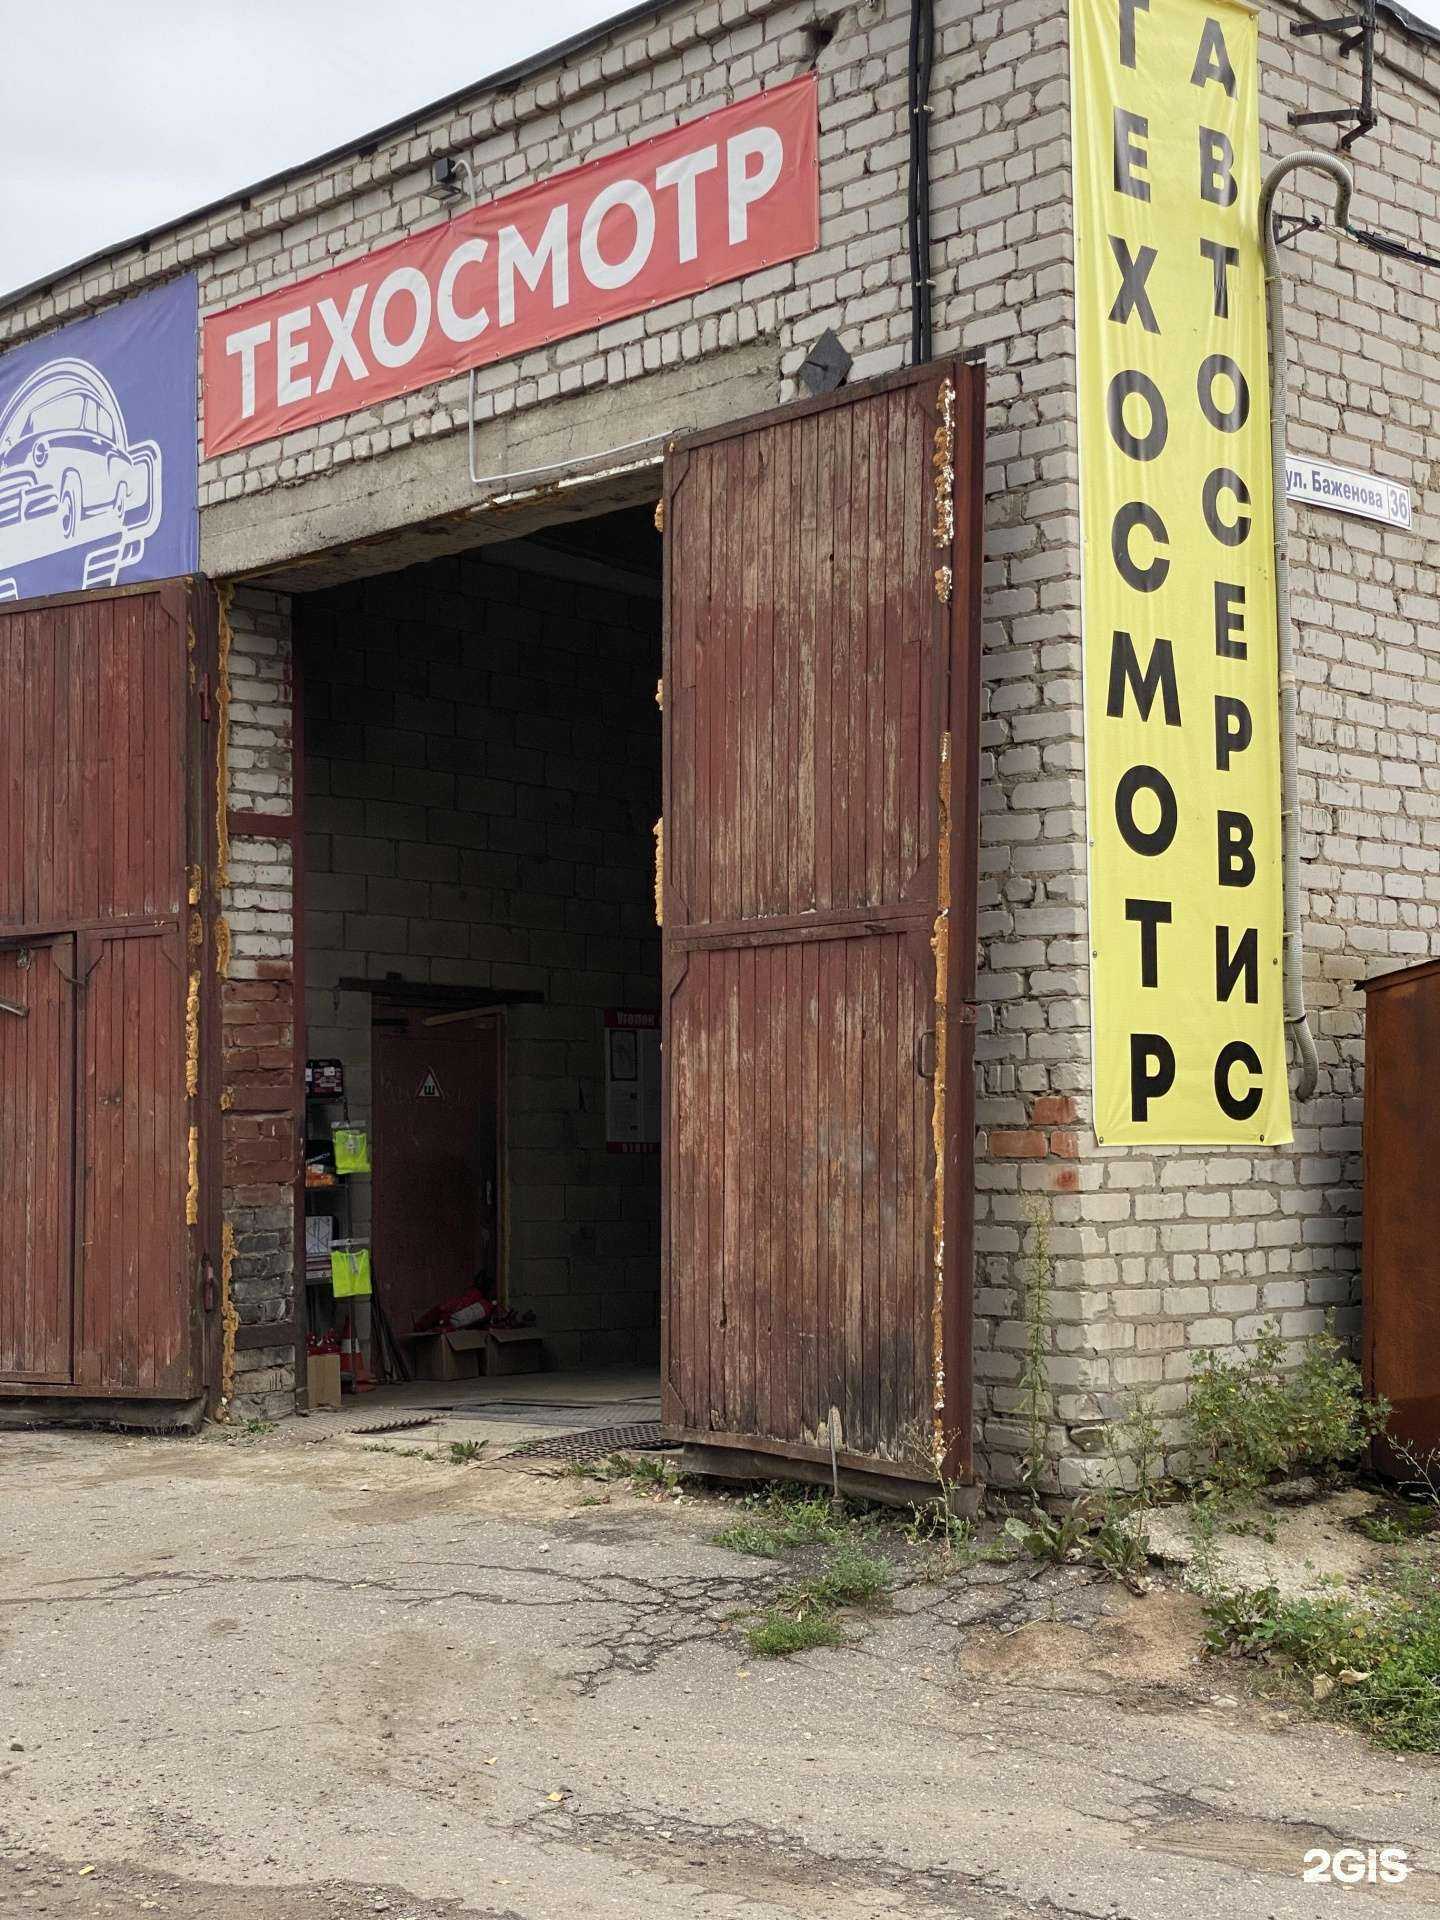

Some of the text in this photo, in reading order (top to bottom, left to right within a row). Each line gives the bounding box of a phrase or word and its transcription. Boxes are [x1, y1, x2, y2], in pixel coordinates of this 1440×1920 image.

[225, 126, 784, 419] ТЕХОСМОТР
[1190, 17, 1264, 1121] АВТОСЕРВИС
[1286, 469, 1408, 520] ул. Баженова 36
